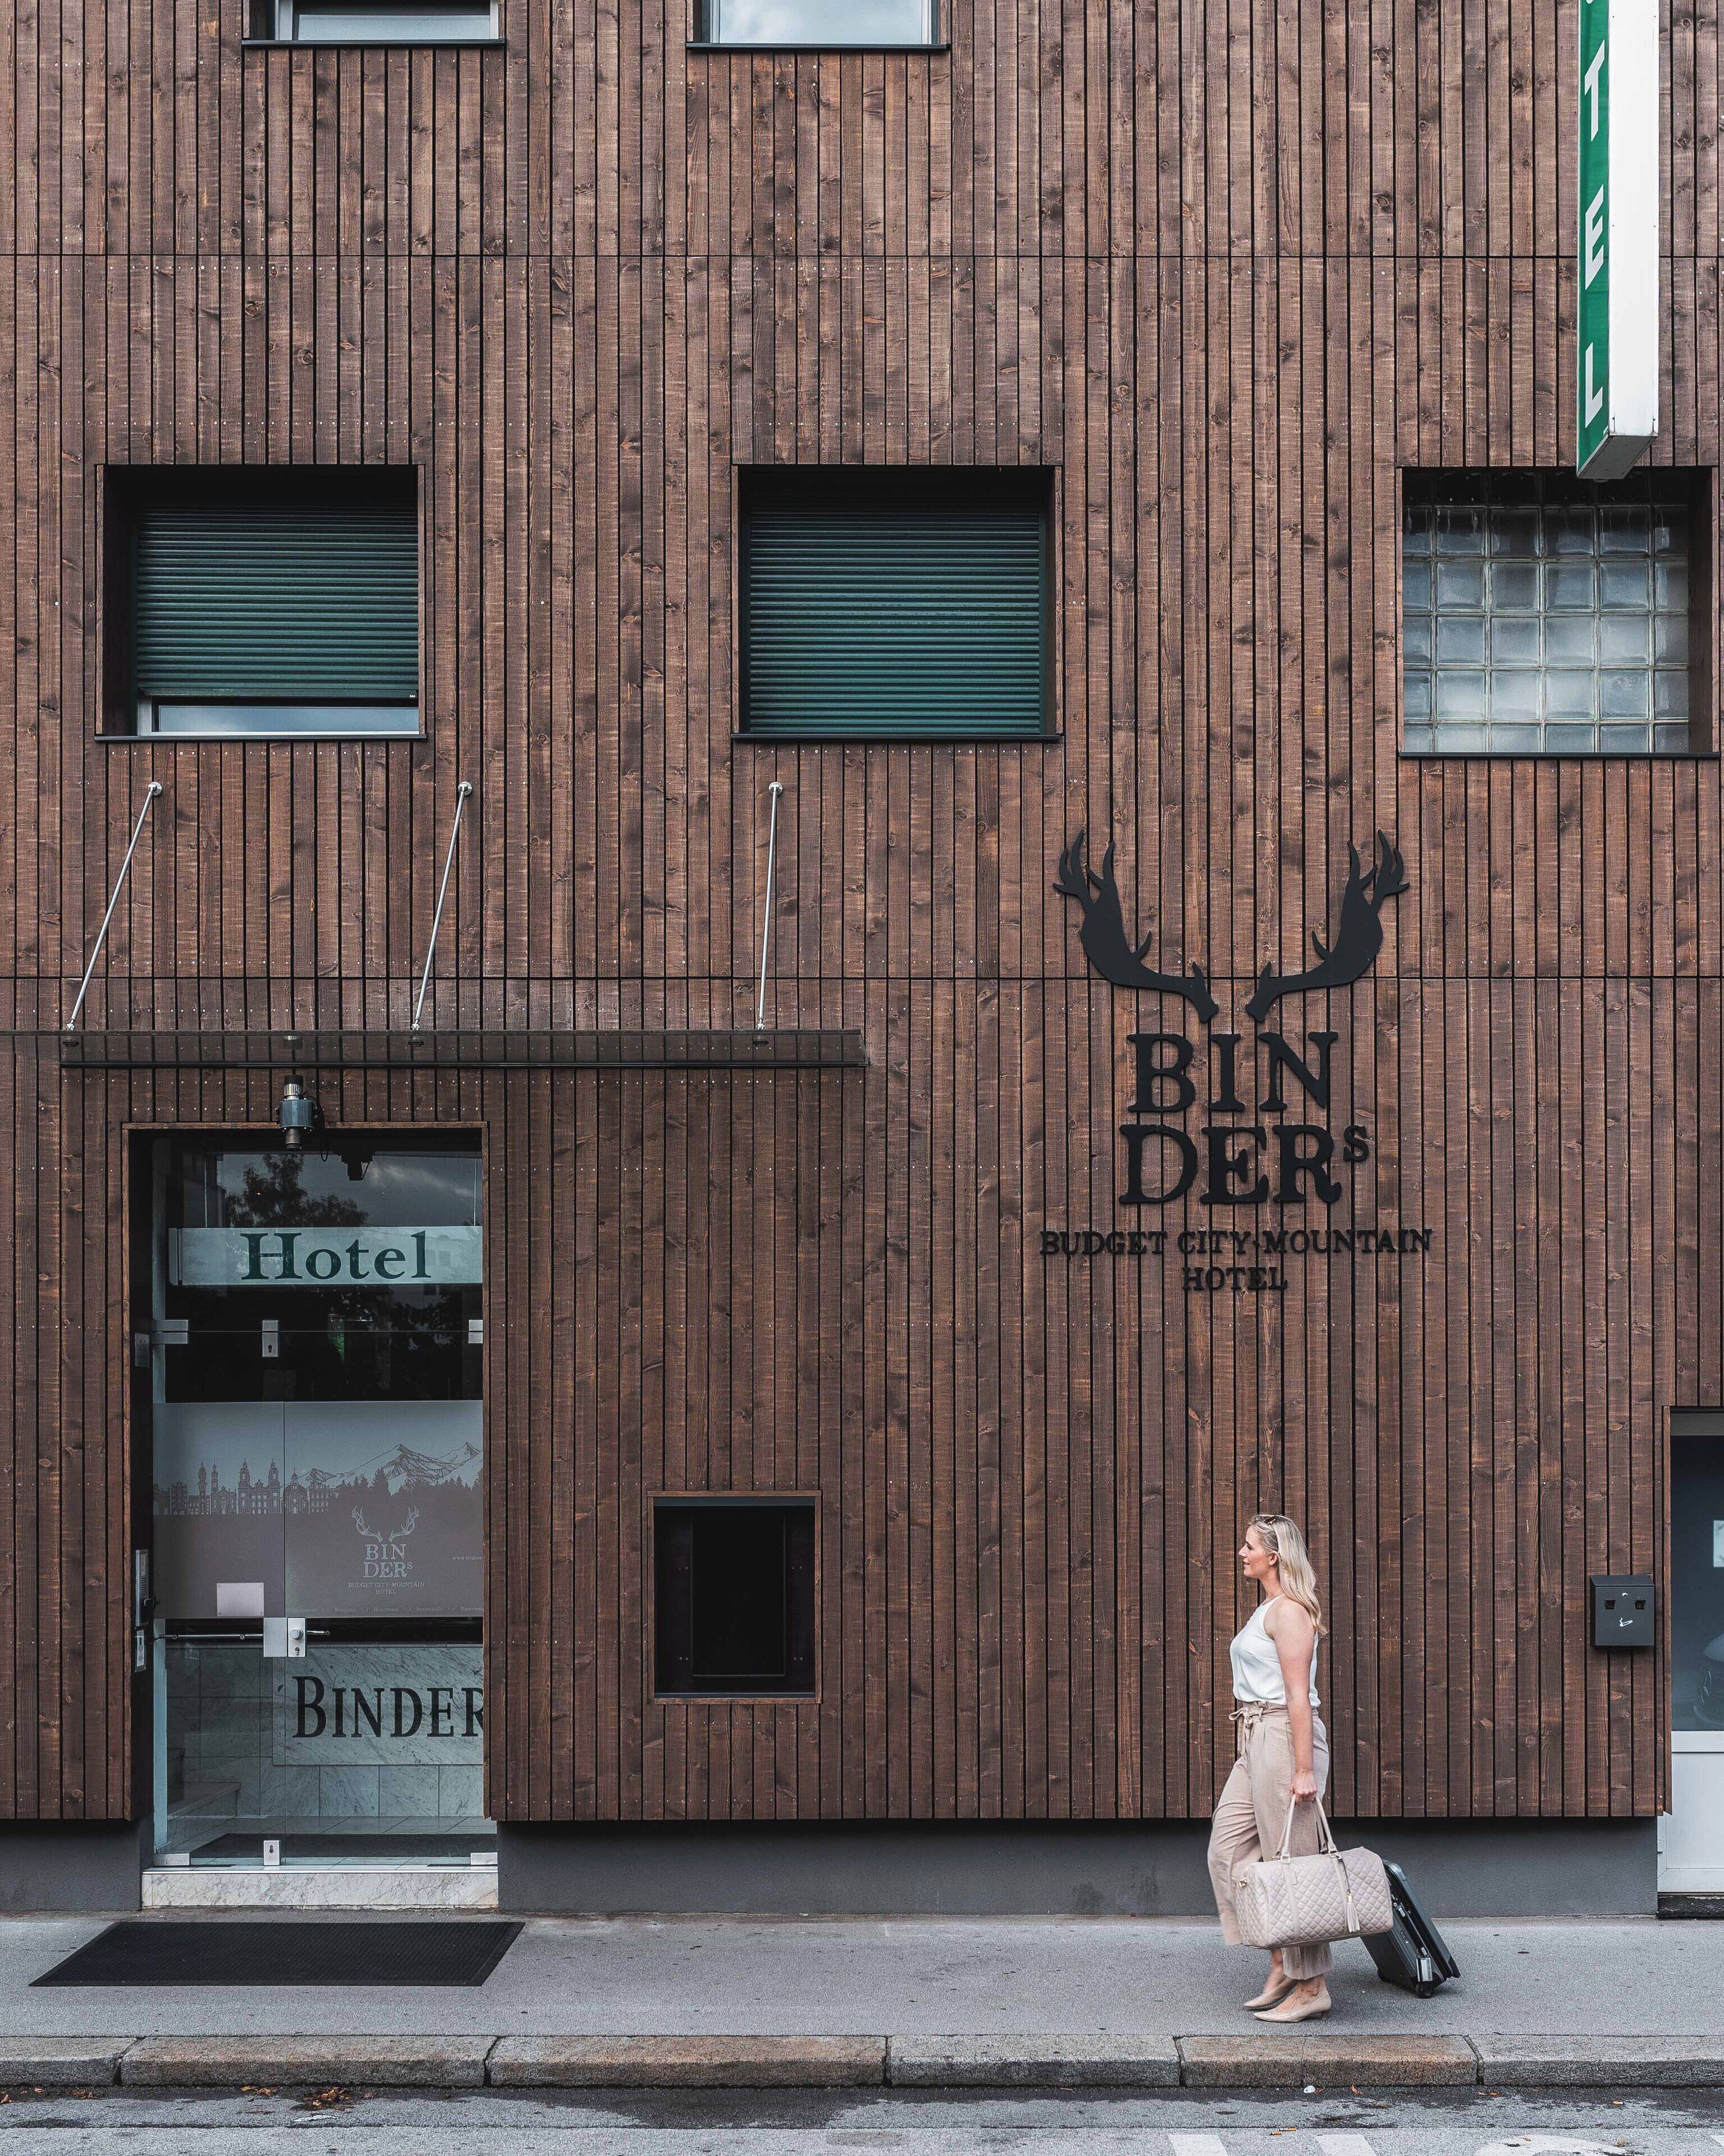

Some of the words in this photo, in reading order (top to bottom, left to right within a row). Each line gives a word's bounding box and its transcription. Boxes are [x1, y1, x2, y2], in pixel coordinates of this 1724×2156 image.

[1584, 0, 1605, 428] TEL
[1127, 1031, 1339, 1113] BIN
[1118, 1124, 1370, 1205] DERS
[240, 1230, 432, 1280] Hotel
[1039, 1230, 1168, 1255] BUDGET
[1182, 1266, 1288, 1291] HOTEL
[365, 1544, 406, 1560] BIN
